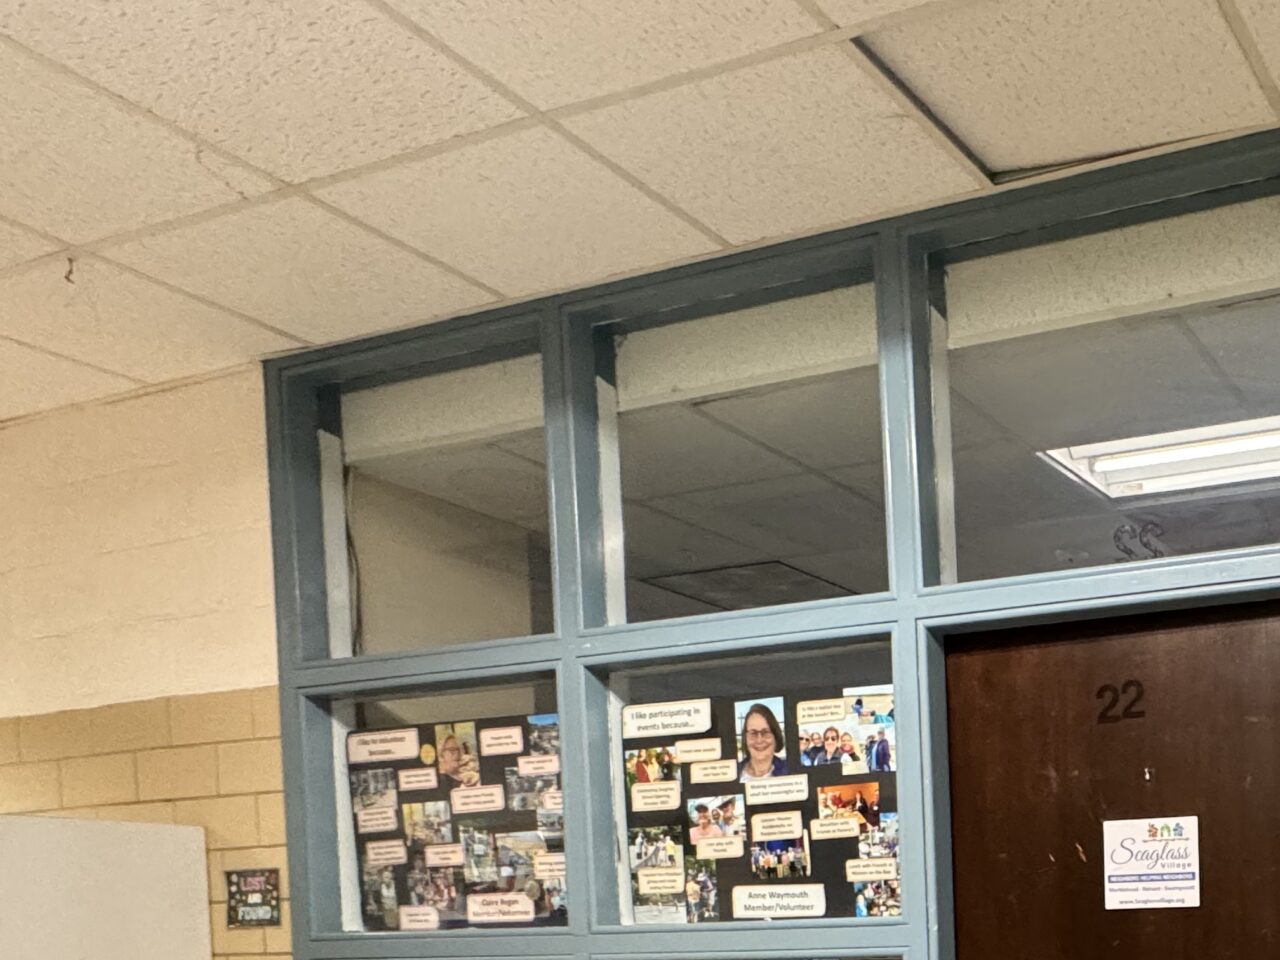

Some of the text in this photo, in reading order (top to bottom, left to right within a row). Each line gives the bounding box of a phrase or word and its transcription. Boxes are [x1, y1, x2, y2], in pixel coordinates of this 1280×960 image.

[1096, 679, 1145, 724] 22
[649, 707, 692, 720] participating
[1111, 837, 1190, 870] Seaglass
[1160, 862, 1192, 870] Village
[240, 876, 266, 891] LOST
[748, 891, 767, 899] Anne
[743, 903, 815, 913] Member/Volunteer
